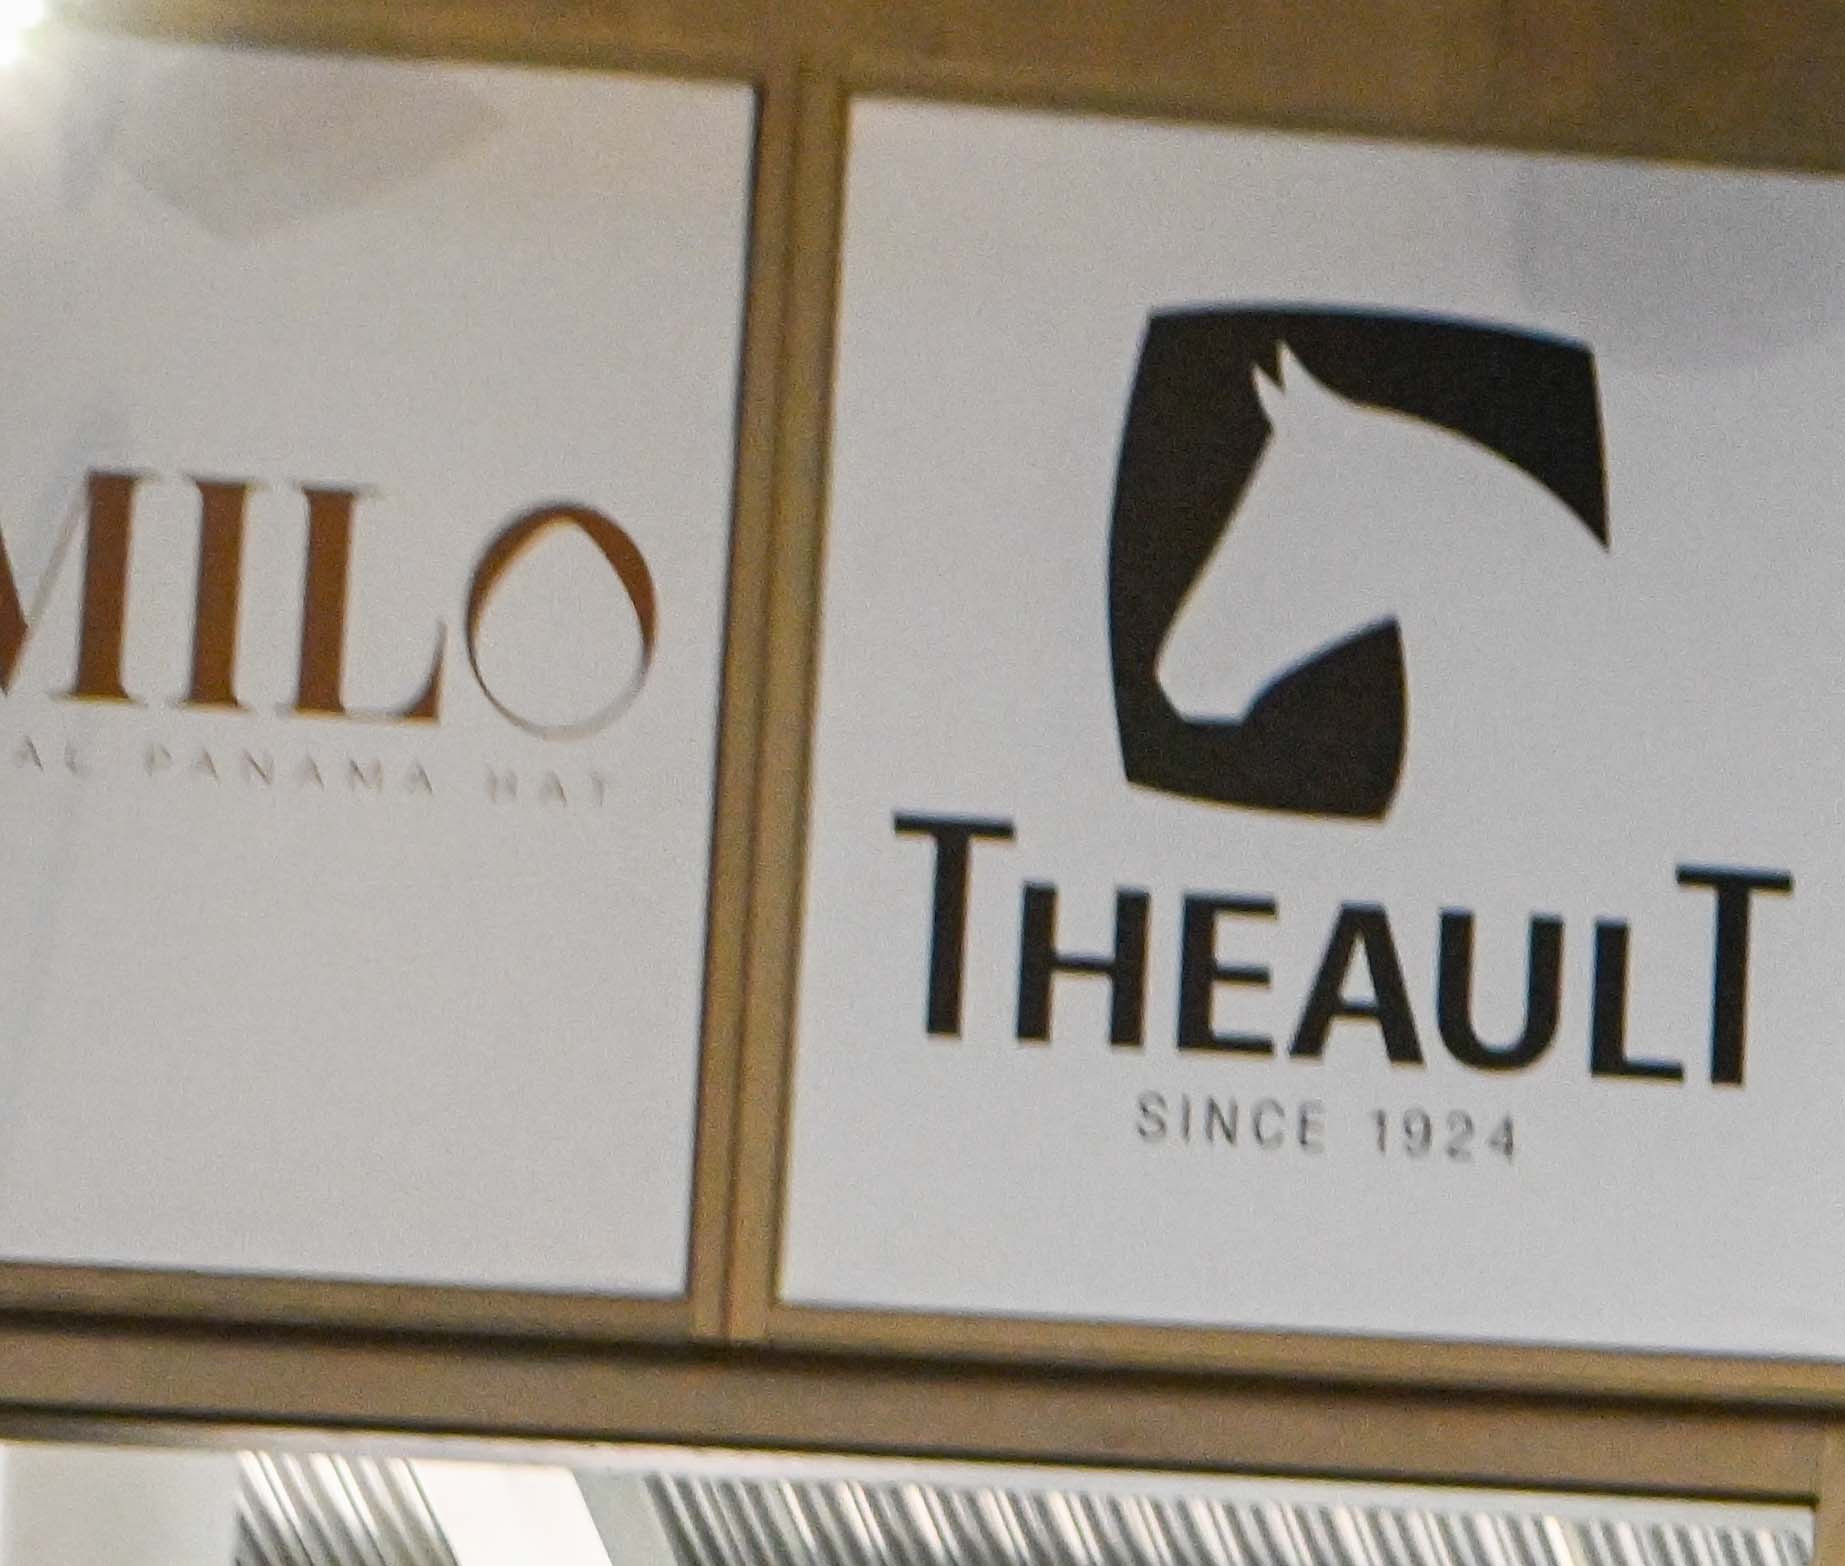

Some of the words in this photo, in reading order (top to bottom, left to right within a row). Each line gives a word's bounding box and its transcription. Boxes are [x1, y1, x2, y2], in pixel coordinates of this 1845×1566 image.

[143, 742, 436, 796] PANAMA
[890, 808, 1794, 1088] THEAULT
[1134, 1090, 1326, 1156] SINCE
[1372, 1108, 1520, 1166] 1924
